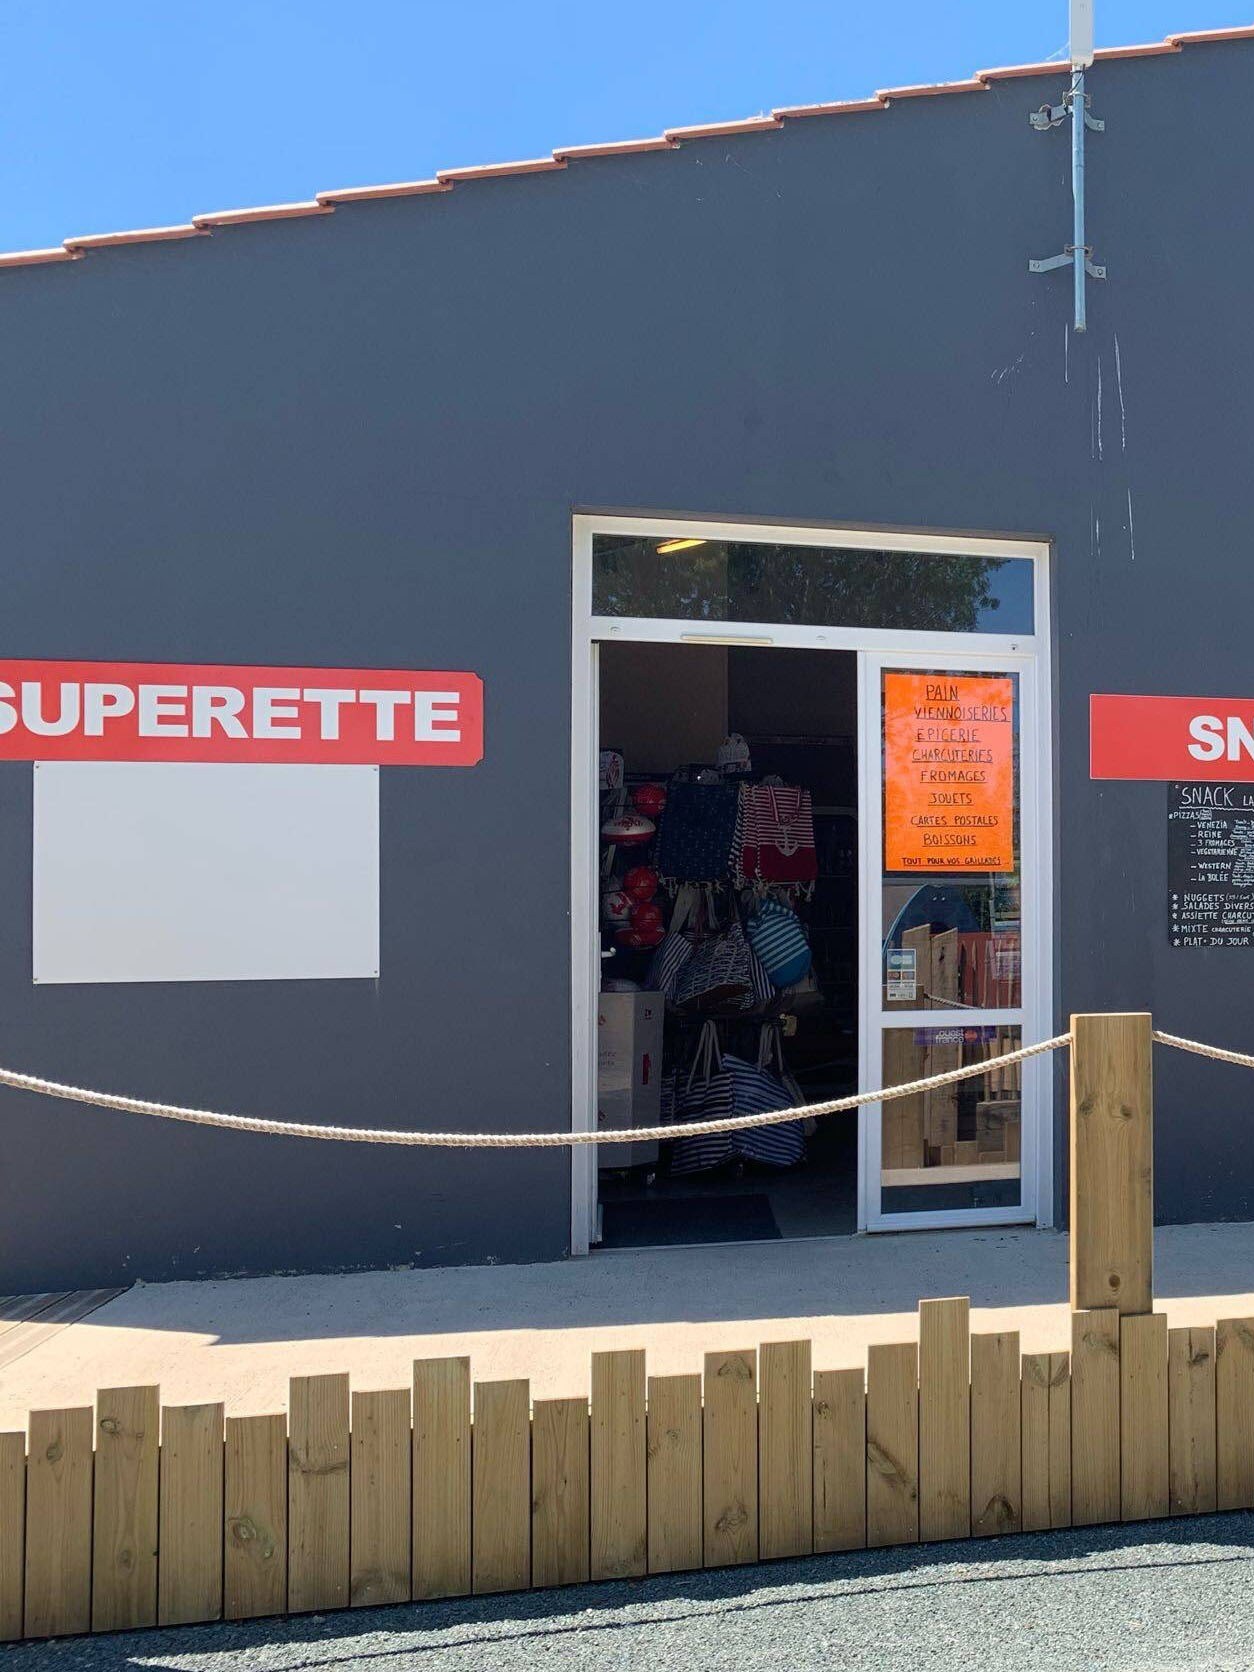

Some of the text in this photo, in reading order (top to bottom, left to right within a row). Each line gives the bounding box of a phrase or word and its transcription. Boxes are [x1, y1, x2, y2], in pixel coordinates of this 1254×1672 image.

[926, 684, 958, 700] PAIN
[914, 705, 1008, 721] VIENNOISERIES
[917, 728, 979, 741] EPICERIE
[912, 749, 993, 762] CHARCUTERIES
[921, 770, 986, 782] FROMAGES
[929, 793, 972, 804] JOUETS
[1181, 786, 1235, 806] SNACK
[1243, 795, 1254, 807] LA
[1173, 811, 1200, 820] PIZZAS
[911, 815, 998, 826] CARTES POSTALES
[1197, 820, 1228, 829] VENEZIA
[923, 833, 977, 845] BOISSONS
[1197, 830, 1222, 839] REINE
[1197, 839, 1203, 847] 3
[1205, 839, 1235, 847] FROMAGES
[902, 857, 921, 865] TOUT
[927, 857, 944, 865] POUR
[948, 857, 960, 865] VOS
[1197, 862, 1232, 870] WESTERN
[1183, 893, 1225, 902] NUGGETS
[1182, 902, 1220, 910] SALADES
[1181, 911, 1218, 920] ASSIETTE
[1181, 924, 1209, 933] MIXTE
[1210, 937, 1224, 945] DU
[1226, 937, 1249, 945] JOUR
[939, 1028, 965, 1037] ouest
[935, 1034, 964, 1044] france
